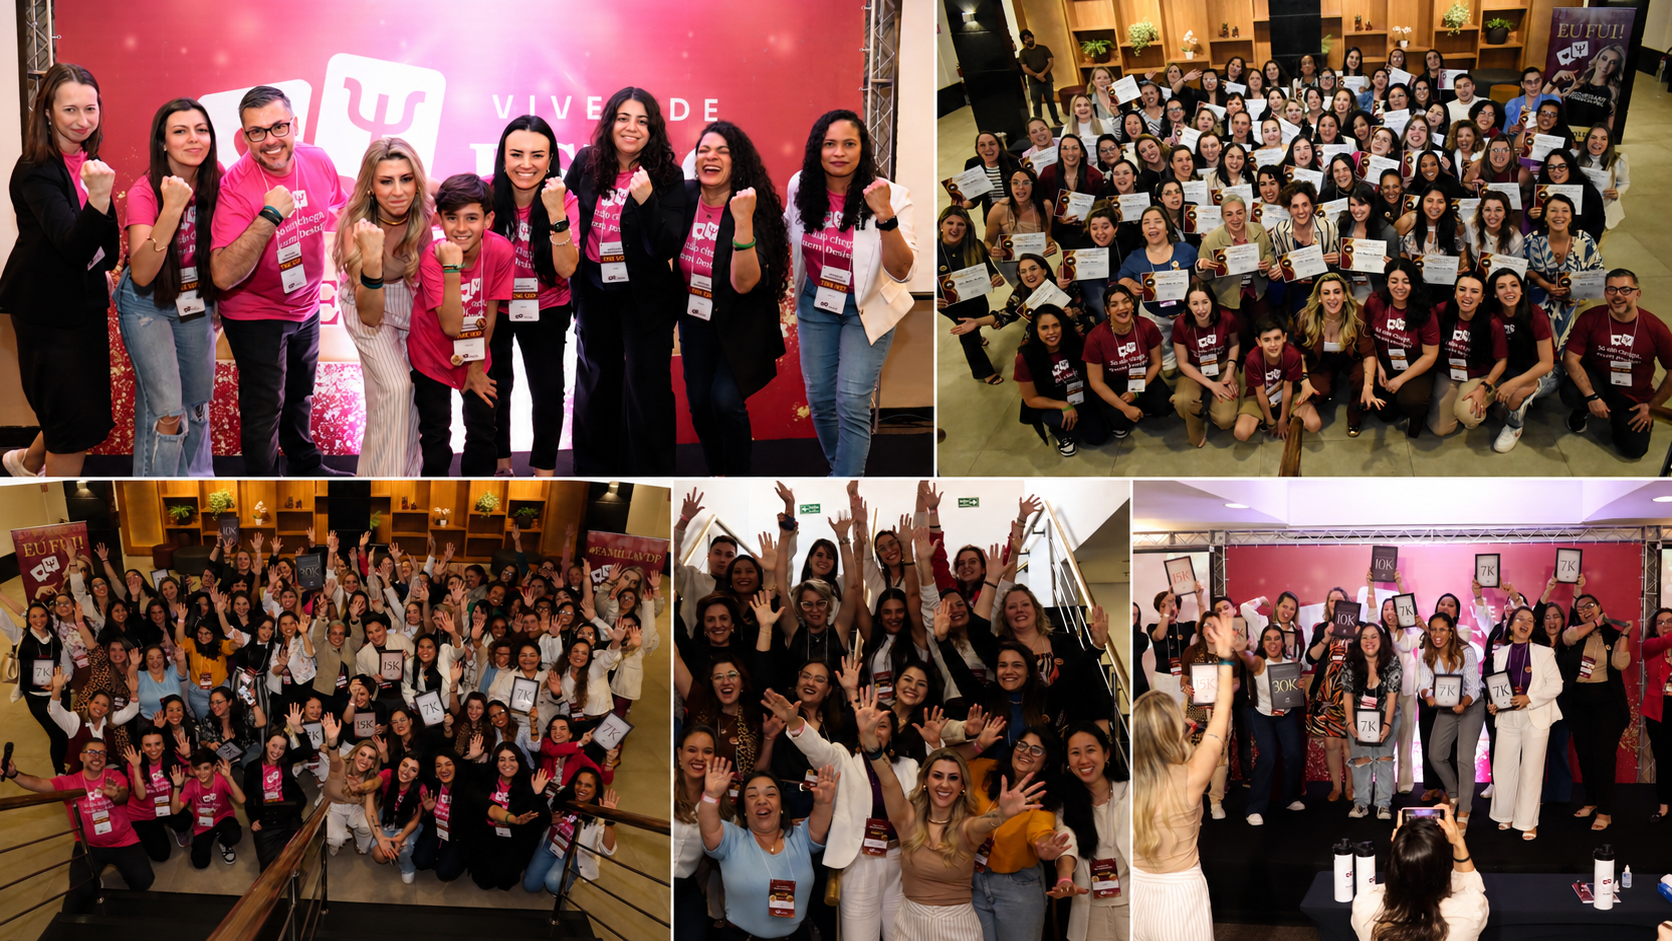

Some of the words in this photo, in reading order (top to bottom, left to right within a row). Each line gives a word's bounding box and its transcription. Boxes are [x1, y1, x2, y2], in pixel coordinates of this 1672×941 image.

[1557, 23, 1583, 38] EU
[1585, 24, 1625, 39] FUI!
[492, 94, 603, 120] VIVE
[669, 97, 719, 122] DE
[23, 541, 47, 558] EU
[1375, 557, 1394, 570] 10K
[1560, 560, 1576, 571] 7K
[1172, 570, 1190, 584] 15K
[1480, 565, 1495, 576] 7K
[1399, 605, 1413, 616] 7K
[1336, 613, 1356, 626] 10K
[36, 667, 52, 677] 7K
[384, 661, 400, 671] 15K
[1195, 678, 1216, 690] 15K
[1272, 678, 1298, 694] 30K
[1439, 684, 1456, 696] 7K
[1492, 683, 1510, 697] 7K
[517, 688, 532, 702] 7K
[422, 701, 440, 715] 7K
[356, 720, 374, 730] 15K
[602, 722, 621, 740] 7K
[1360, 720, 1377, 732] 7K
